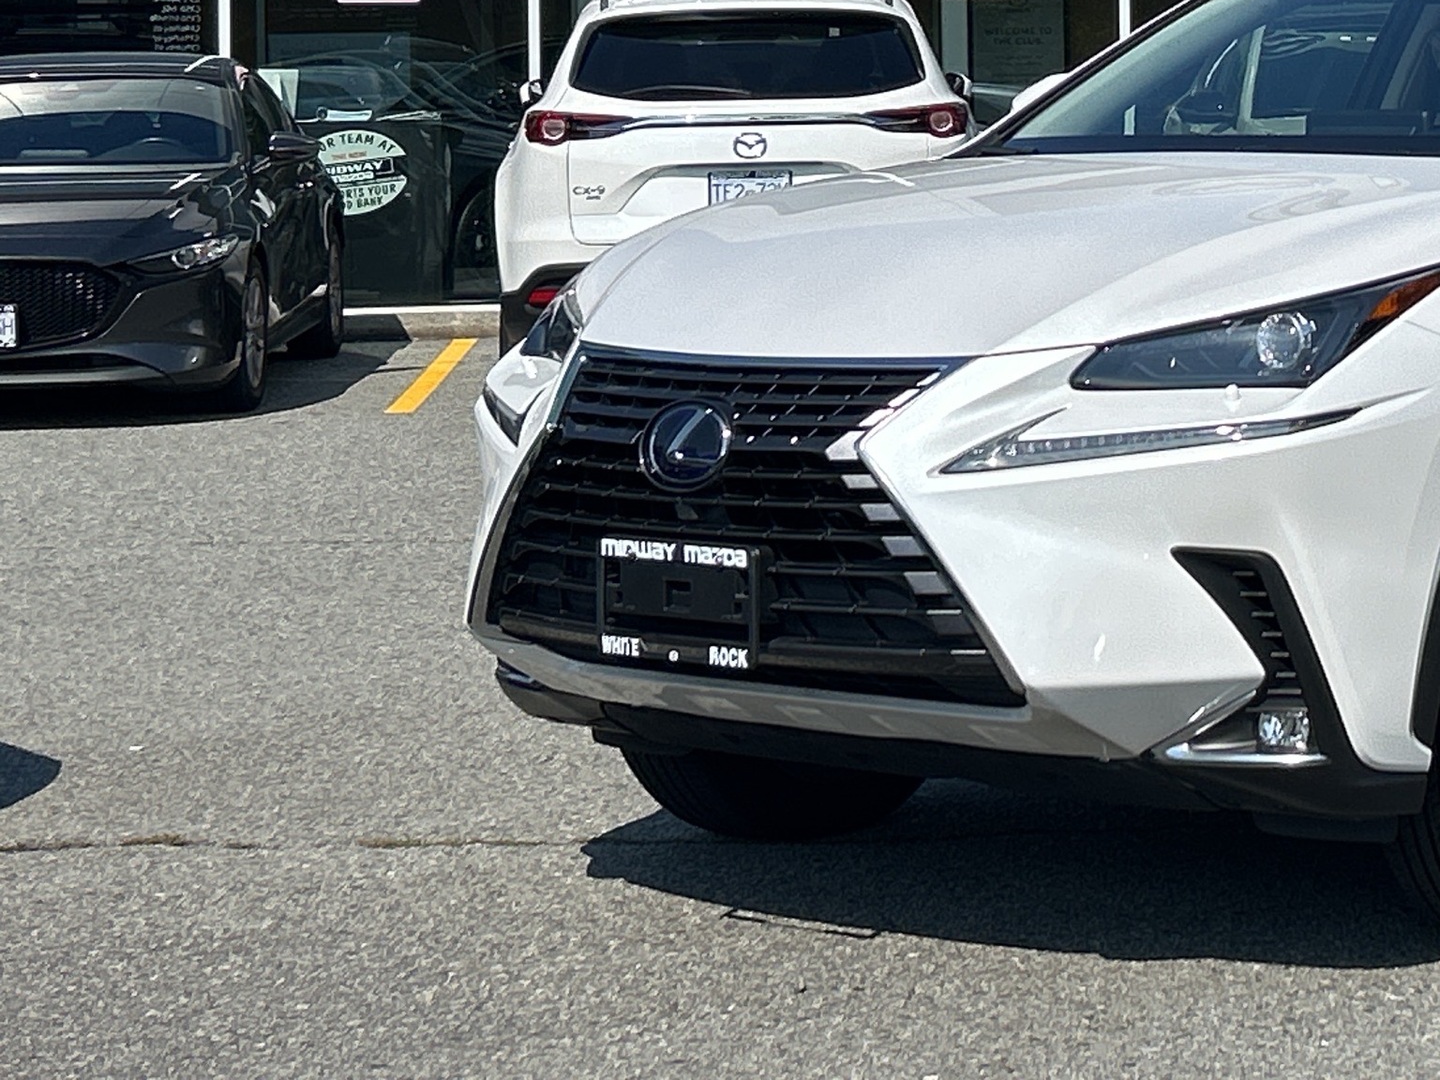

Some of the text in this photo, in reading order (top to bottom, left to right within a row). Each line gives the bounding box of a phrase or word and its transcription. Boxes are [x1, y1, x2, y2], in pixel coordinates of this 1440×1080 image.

[339, 133, 375, 145] TEAM
[378, 140, 397, 153] AT
[367, 183, 397, 196] YOUR
[572, 184, 606, 196] CX-9
[357, 196, 384, 209] BANK
[601, 634, 749, 669] WHITE ROCK
